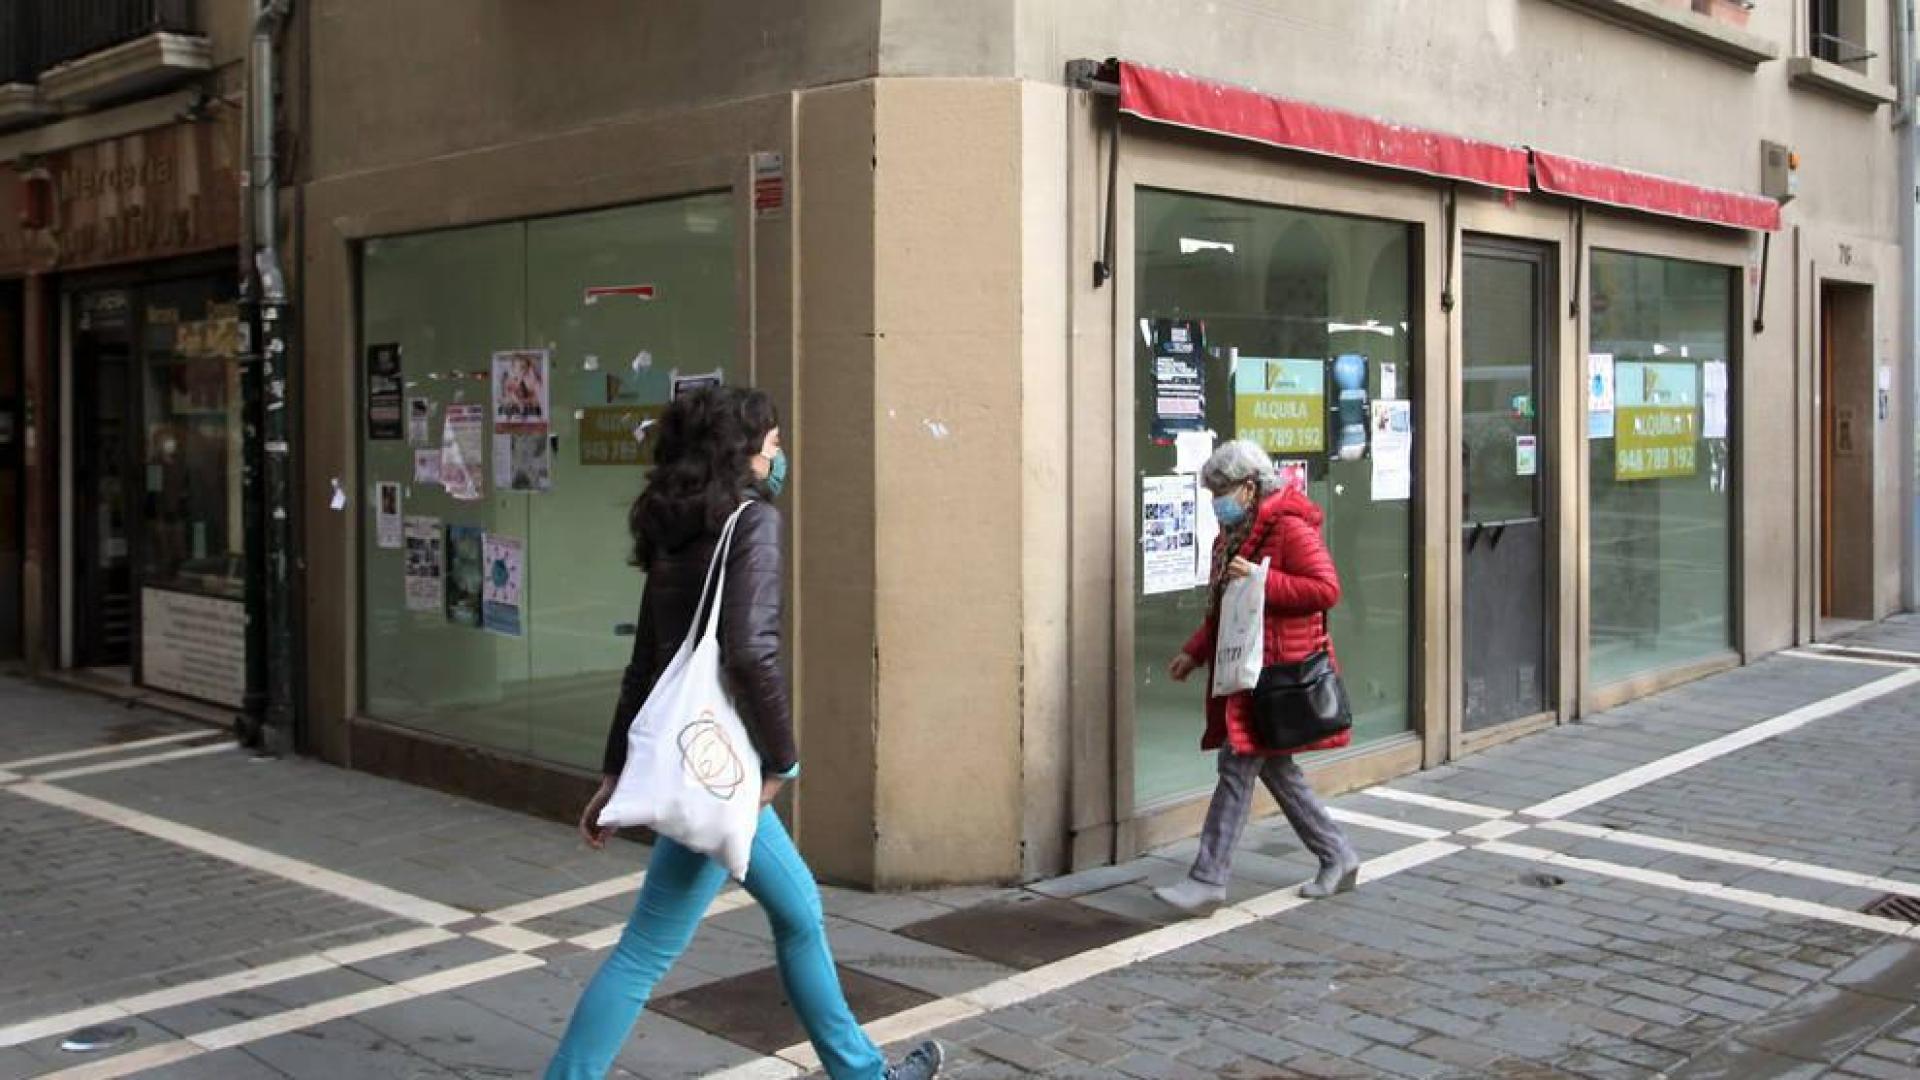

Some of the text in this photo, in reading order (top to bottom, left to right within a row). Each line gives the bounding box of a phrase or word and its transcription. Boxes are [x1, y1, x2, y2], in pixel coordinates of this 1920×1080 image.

[1838, 243, 1853, 266] 76
[1254, 400, 1309, 420] ALQUILA
[1269, 427, 1292, 450] 789
[1296, 427, 1321, 447] 192
[1672, 445, 1694, 470] 192
